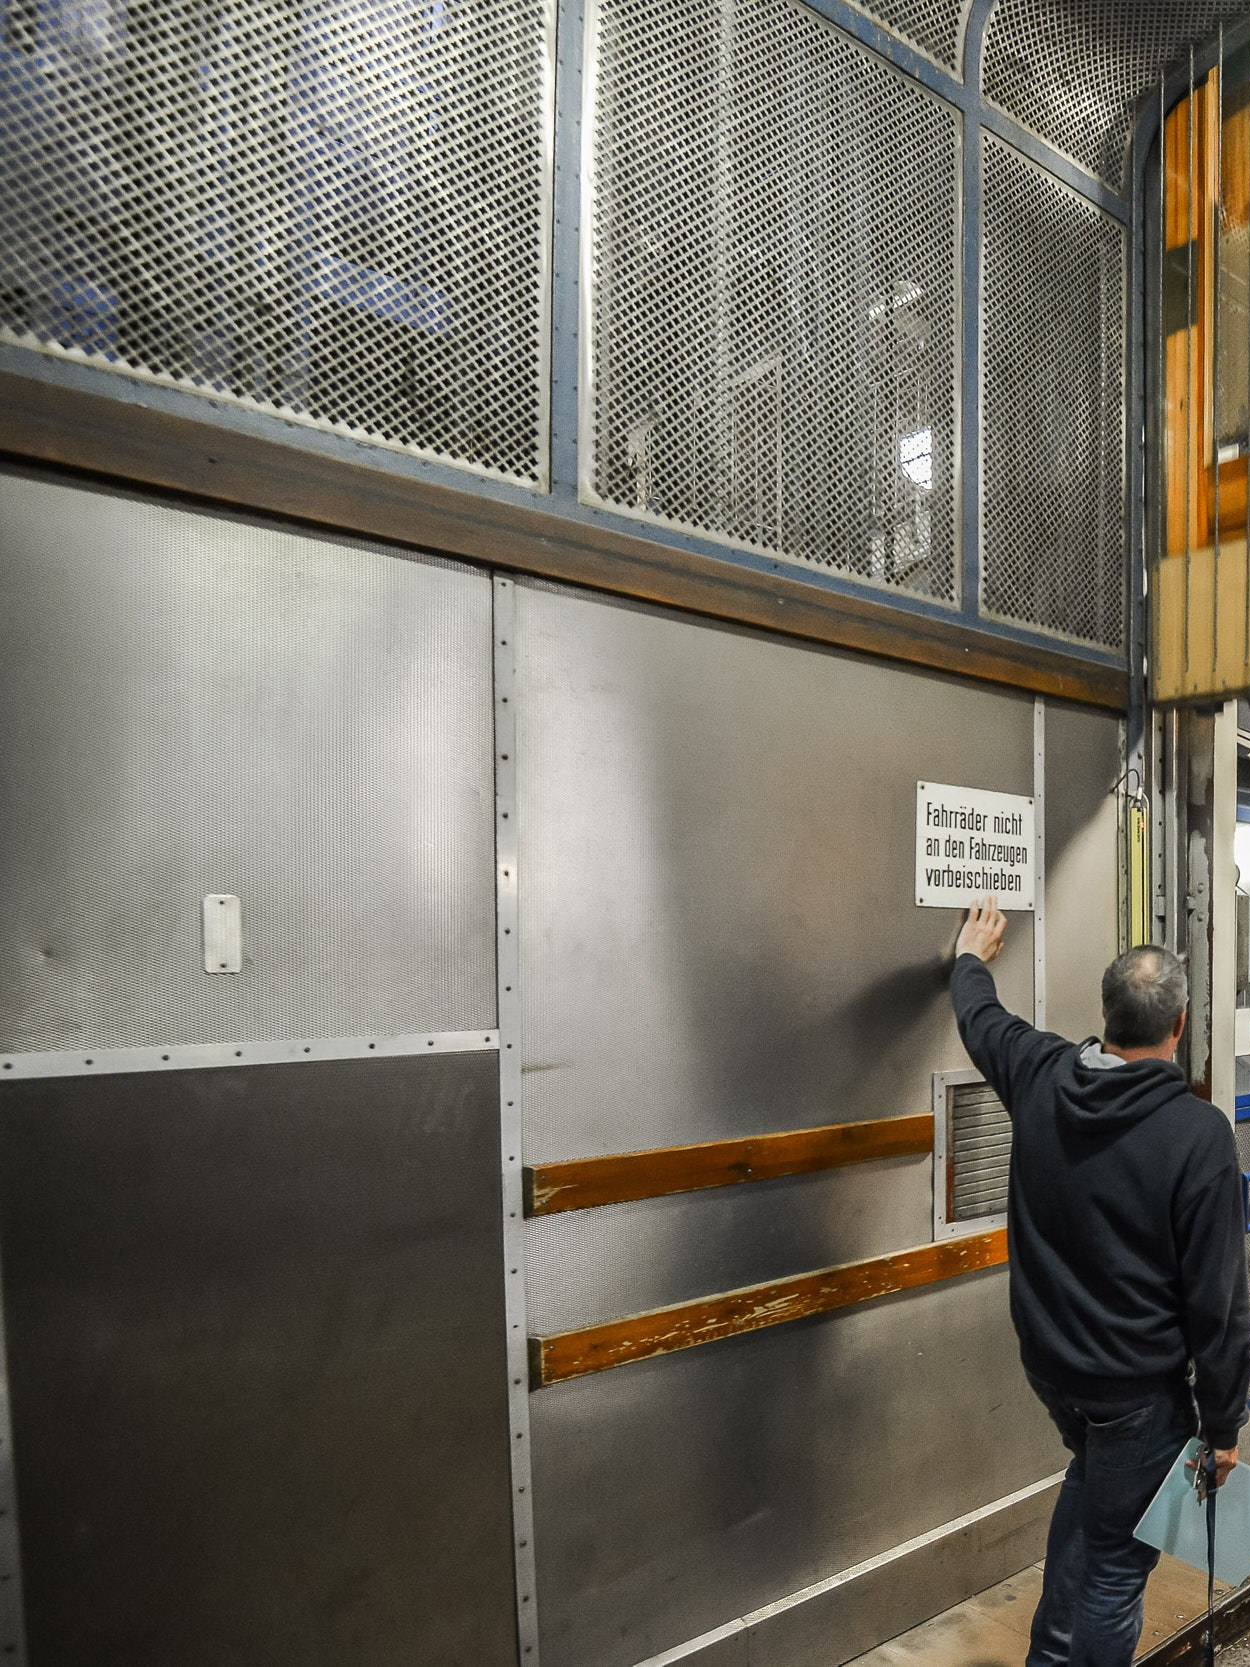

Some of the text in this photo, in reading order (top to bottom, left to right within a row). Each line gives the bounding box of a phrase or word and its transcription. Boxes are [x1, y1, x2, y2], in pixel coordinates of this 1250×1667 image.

[926, 801, 1023, 836] Fahrräder nicht
[926, 834, 1028, 867] an den Fahrzeugen
[925, 864, 1022, 892] vorbeischieben
